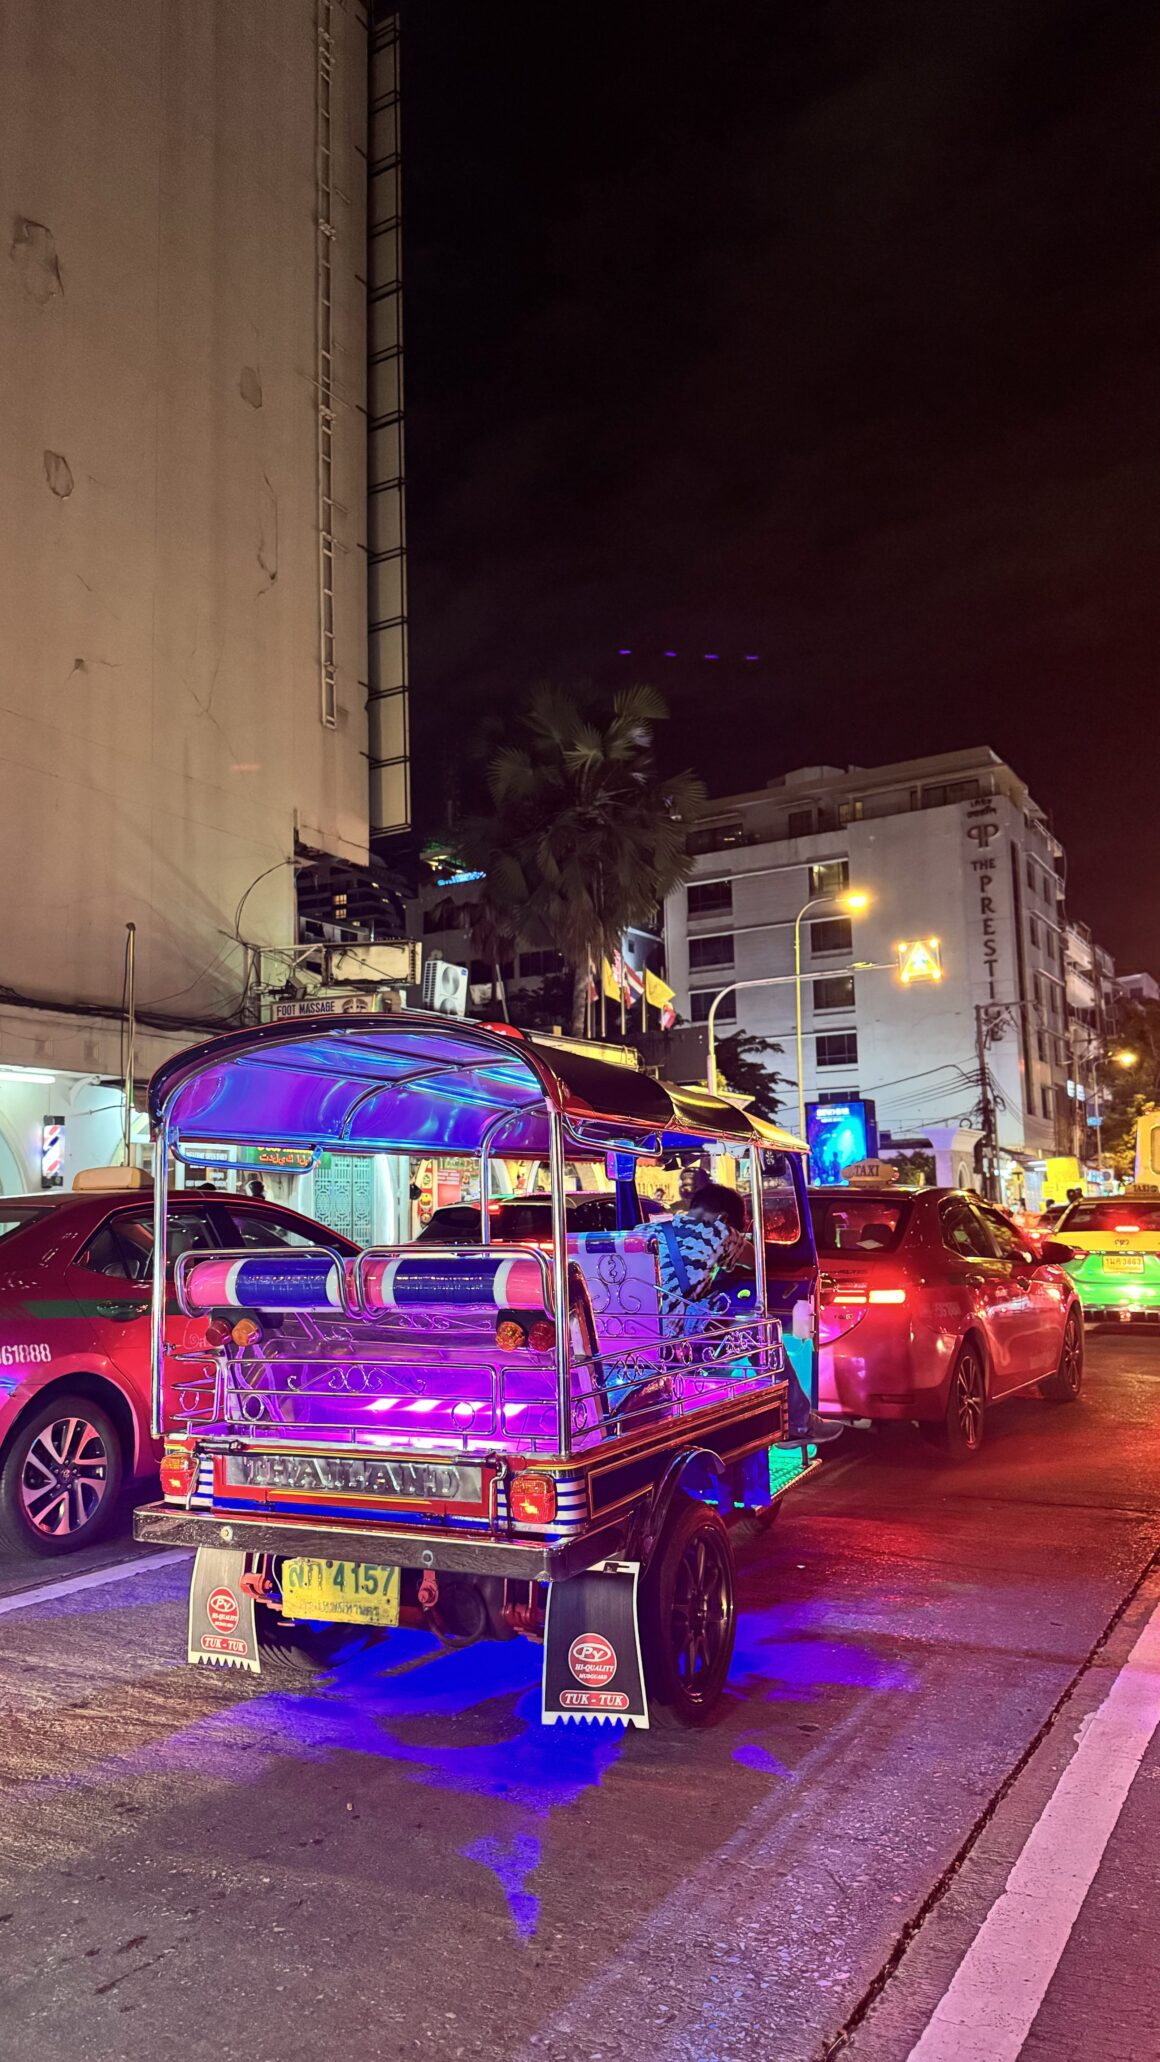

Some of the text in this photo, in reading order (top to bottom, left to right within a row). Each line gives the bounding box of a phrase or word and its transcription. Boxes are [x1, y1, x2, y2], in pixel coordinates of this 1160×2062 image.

[971, 857, 996, 872] THE
[276, 1001, 335, 1016] FOOT MASSAGE
[854, 1164, 880, 1177] TAXI
[1132, 1184, 1150, 1192] TAXI
[0, 1343, 52, 1366] 61888
[332, 1561, 396, 1597] 4157
[215, 1597, 231, 1610] PY
[204, 1637, 222, 1648] TUK
[228, 1641, 244, 1652] TUK
[581, 1646, 605, 1660] PY
[575, 1663, 614, 1672] HI-QUALITY
[565, 1693, 589, 1704] TUK
[599, 1694, 623, 1706] TUK
